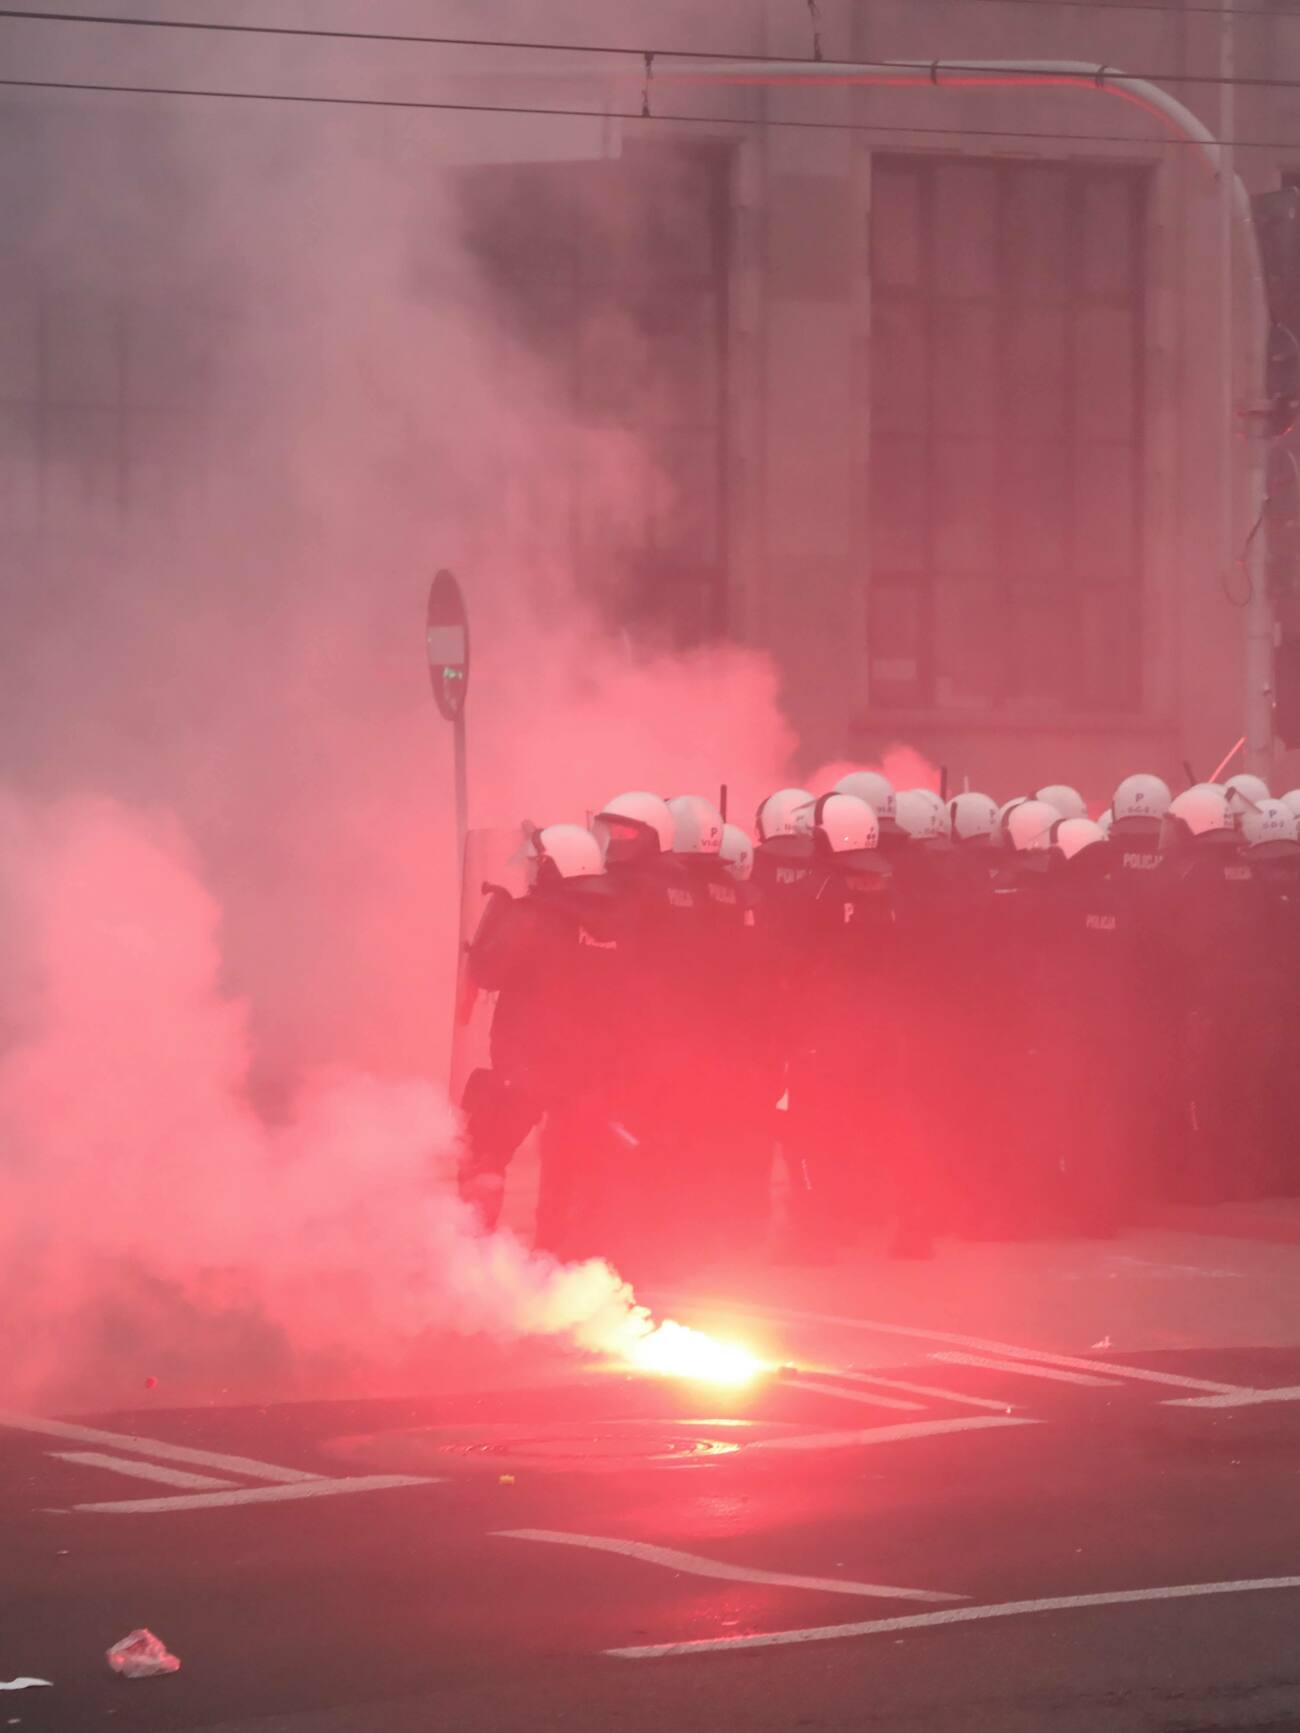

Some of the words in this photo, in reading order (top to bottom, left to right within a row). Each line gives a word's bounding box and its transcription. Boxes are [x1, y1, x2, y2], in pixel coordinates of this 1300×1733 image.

[1135, 793, 1145, 802] P
[1268, 809, 1278, 819] P
[710, 827, 718, 837] P
